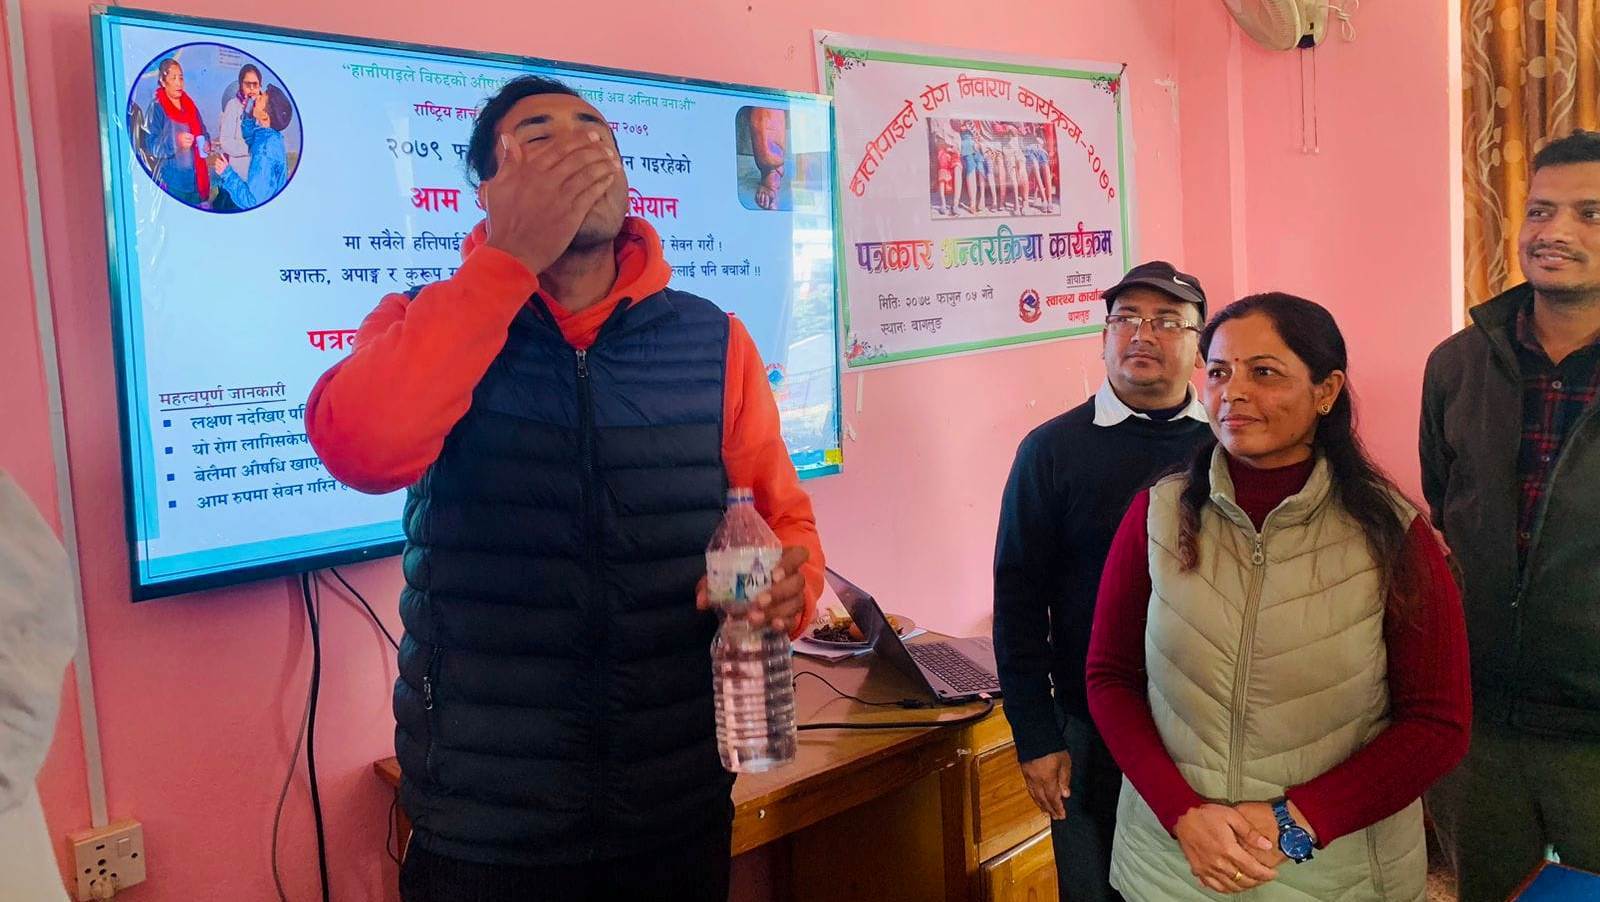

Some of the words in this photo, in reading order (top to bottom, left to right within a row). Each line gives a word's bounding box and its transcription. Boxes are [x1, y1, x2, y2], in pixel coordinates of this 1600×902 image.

[919, 84, 950, 111] रोग
[957, 73, 1012, 101] निवारण
[622, 122, 649, 136] २०७९
[386, 138, 443, 161] २०७९
[640, 152, 692, 175] गइरहेको
[410, 186, 461, 213] आम
[624, 187, 680, 218] भियान
[343, 235, 361, 250] मा
[669, 235, 693, 251] सेवन
[855, 239, 935, 273] पत्रकार
[941, 223, 1044, 268] अन्तरक्रिया
[1047, 221, 1113, 260] कार्यक्रम
[386, 267, 399, 282] र
[701, 260, 718, 277] पनि
[227, 380, 286, 400] जानकारी
[190, 414, 232, 430] लक्षण
[236, 407, 286, 426] नदेखिए
[192, 438, 210, 456] यो
[214, 437, 236, 454] रोग
[197, 493, 228, 509] आम
[272, 482, 303, 499] सेवन
